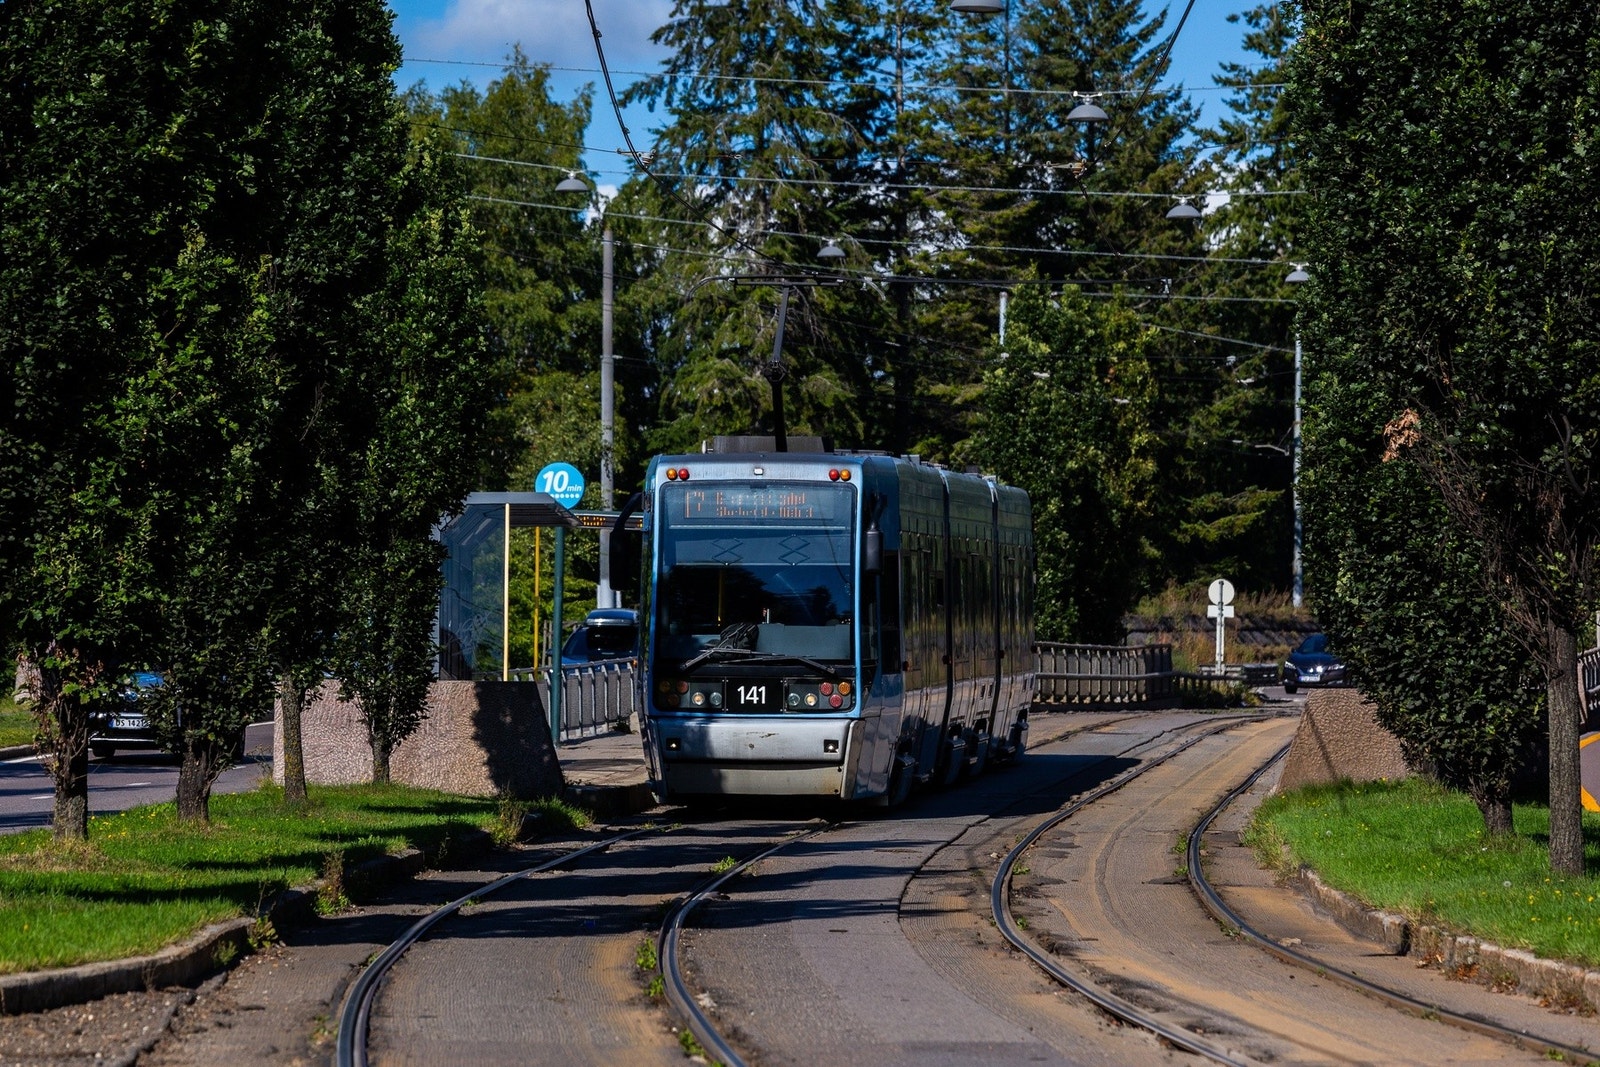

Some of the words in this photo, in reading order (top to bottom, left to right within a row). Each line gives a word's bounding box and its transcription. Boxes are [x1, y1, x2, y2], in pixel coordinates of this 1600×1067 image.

[543, 470, 569, 492] 10
[566, 484, 582, 492] min
[737, 685, 766, 705] 141
